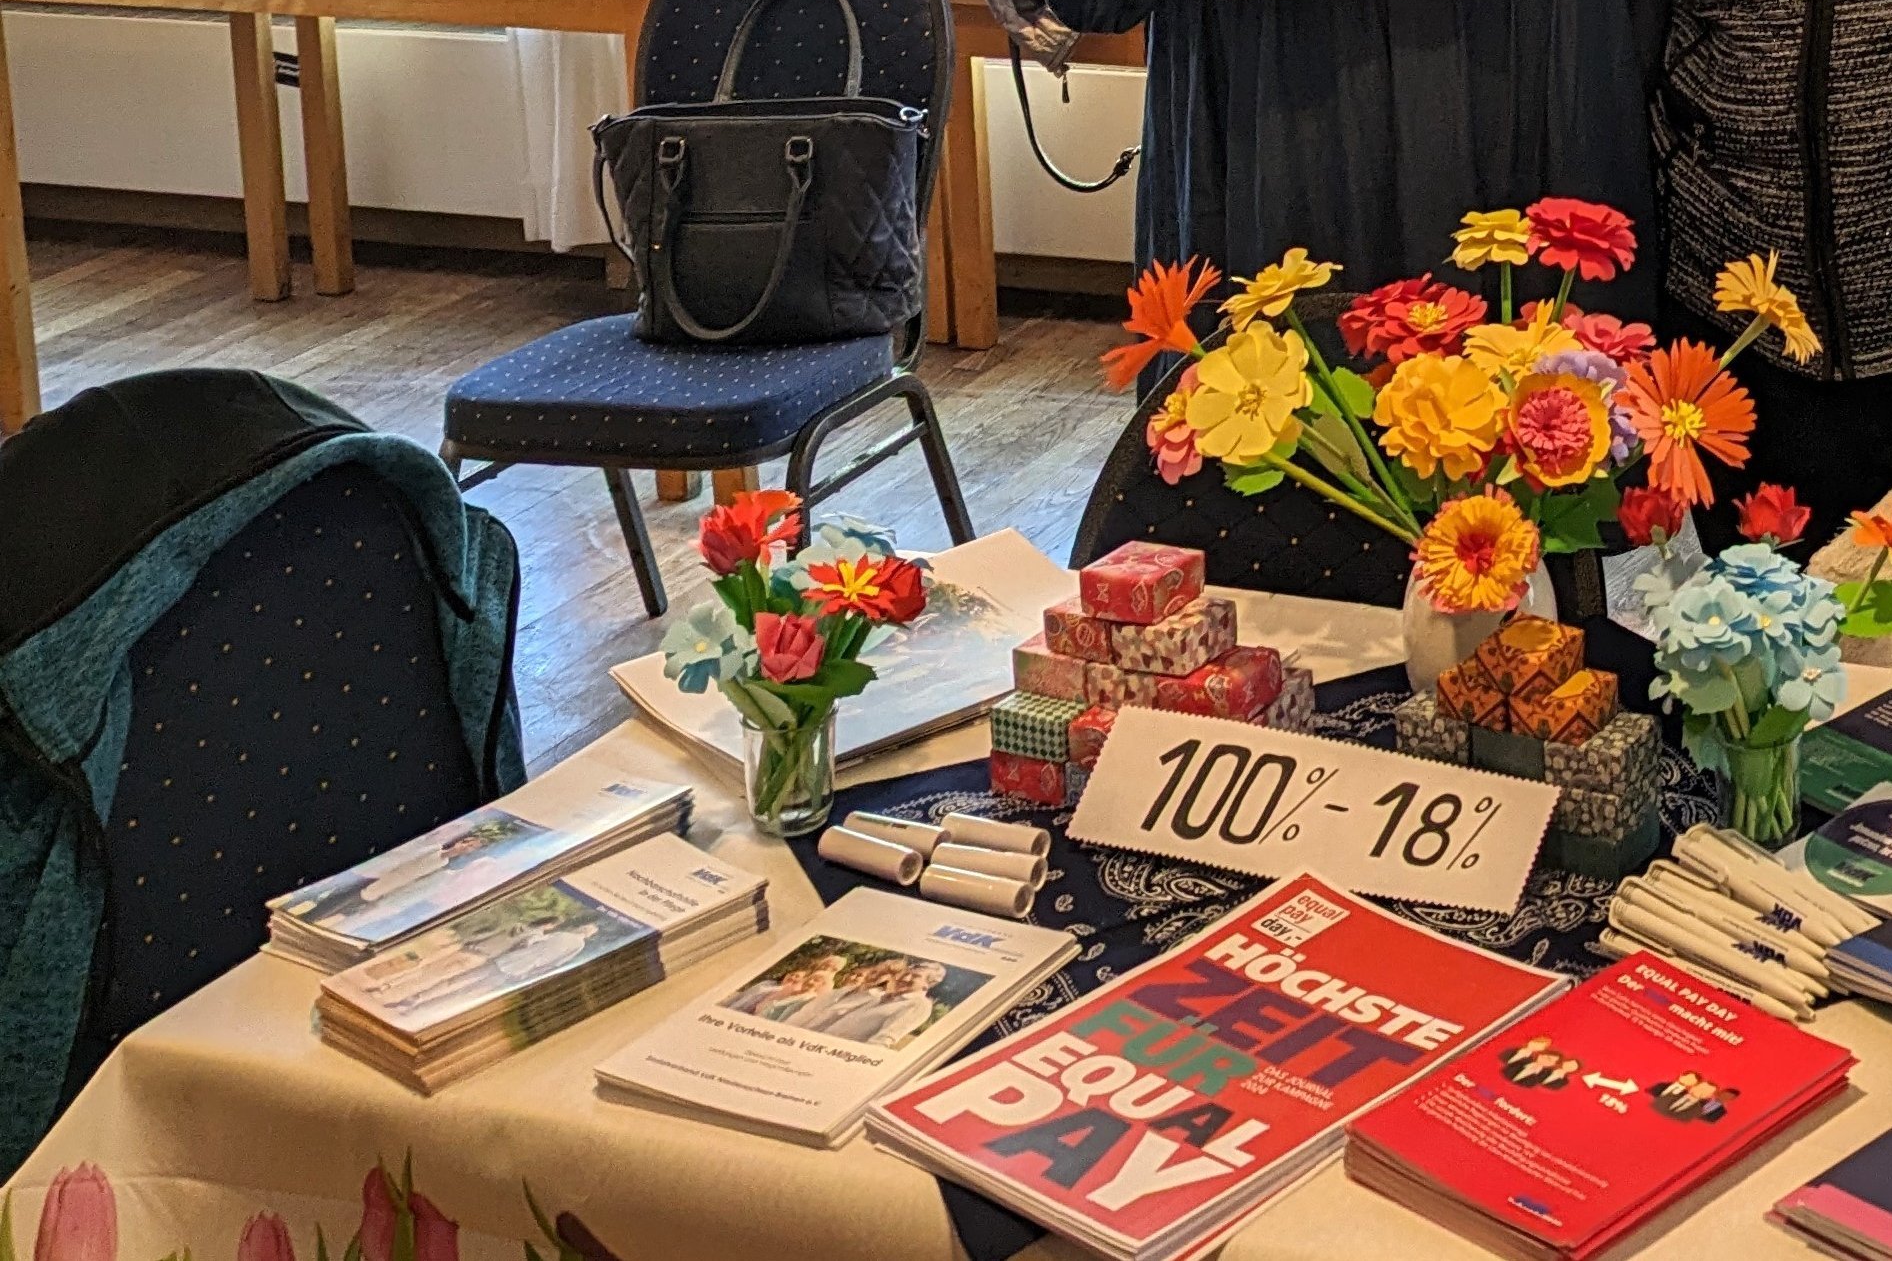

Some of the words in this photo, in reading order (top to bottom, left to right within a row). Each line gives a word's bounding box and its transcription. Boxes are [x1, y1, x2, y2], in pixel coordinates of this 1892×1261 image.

[1140, 739, 1339, 845] 100%
[1369, 782, 1502, 871] 18%
[1260, 917, 1293, 937] day
[1278, 904, 1314, 924] pay
[1297, 895, 1345, 921] equal
[1203, 933, 1465, 1052] HÖCHSTE
[1617, 974, 1646, 993] Der
[1635, 963, 1679, 992] EQUAL
[1677, 986, 1709, 1008] PAY
[1704, 1001, 1739, 1023] DAY
[697, 1013, 725, 1028] Ihre
[776, 1035, 795, 1047] als
[798, 1040, 884, 1068] VdK-Mitglied
[1069, 998, 1257, 1097] FÜR
[1129, 960, 1428, 1088] ZEIT
[914, 1061, 1236, 1211] PAY
[1016, 1031, 1272, 1167] EQUAL
